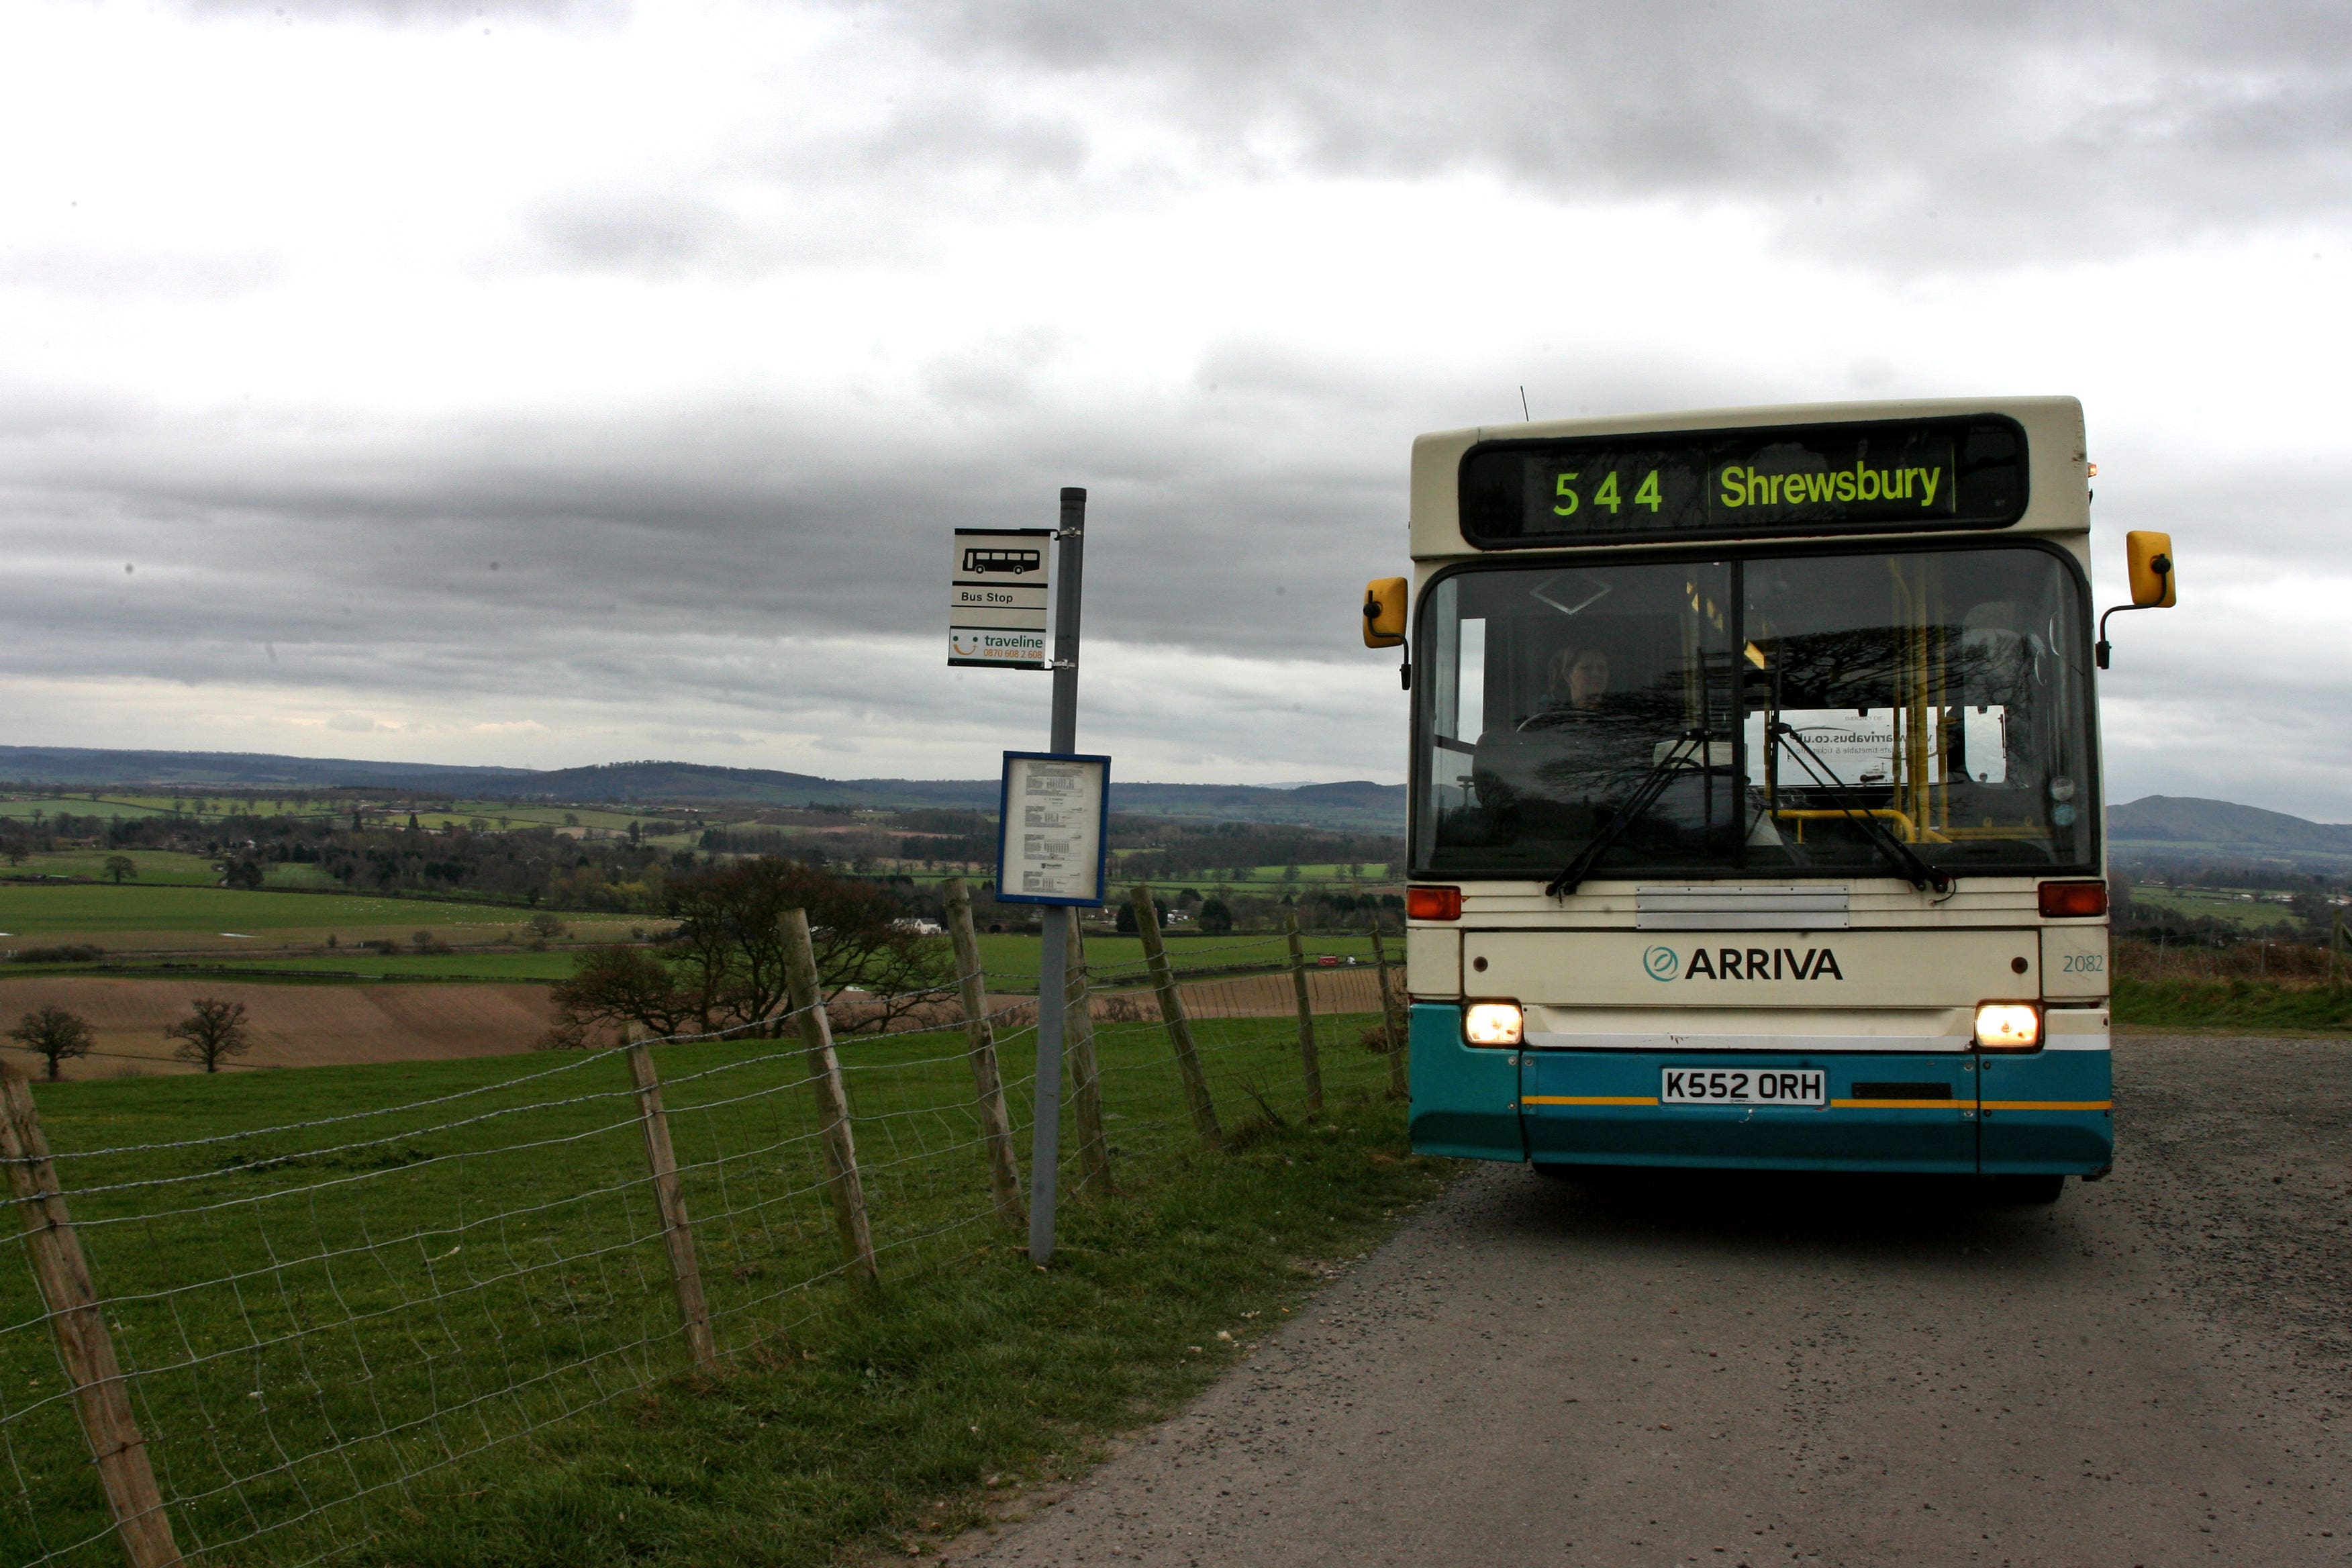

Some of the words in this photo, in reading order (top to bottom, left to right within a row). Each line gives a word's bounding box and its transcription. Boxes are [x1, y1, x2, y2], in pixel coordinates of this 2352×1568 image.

[1720, 460, 1941, 507] Shrewsbury
[961, 592, 982, 601] Bus
[987, 593, 1013, 604] Stop
[984, 635, 1043, 648] traveline
[983, 648, 1003, 657] 0870
[1028, 650, 1042, 658] 608
[1685, 948, 1843, 980] ARRIVA
[2063, 955, 2103, 972] 2082
[1667, 1072, 1749, 1098] K552
[1759, 1073, 1820, 1099] ORH
